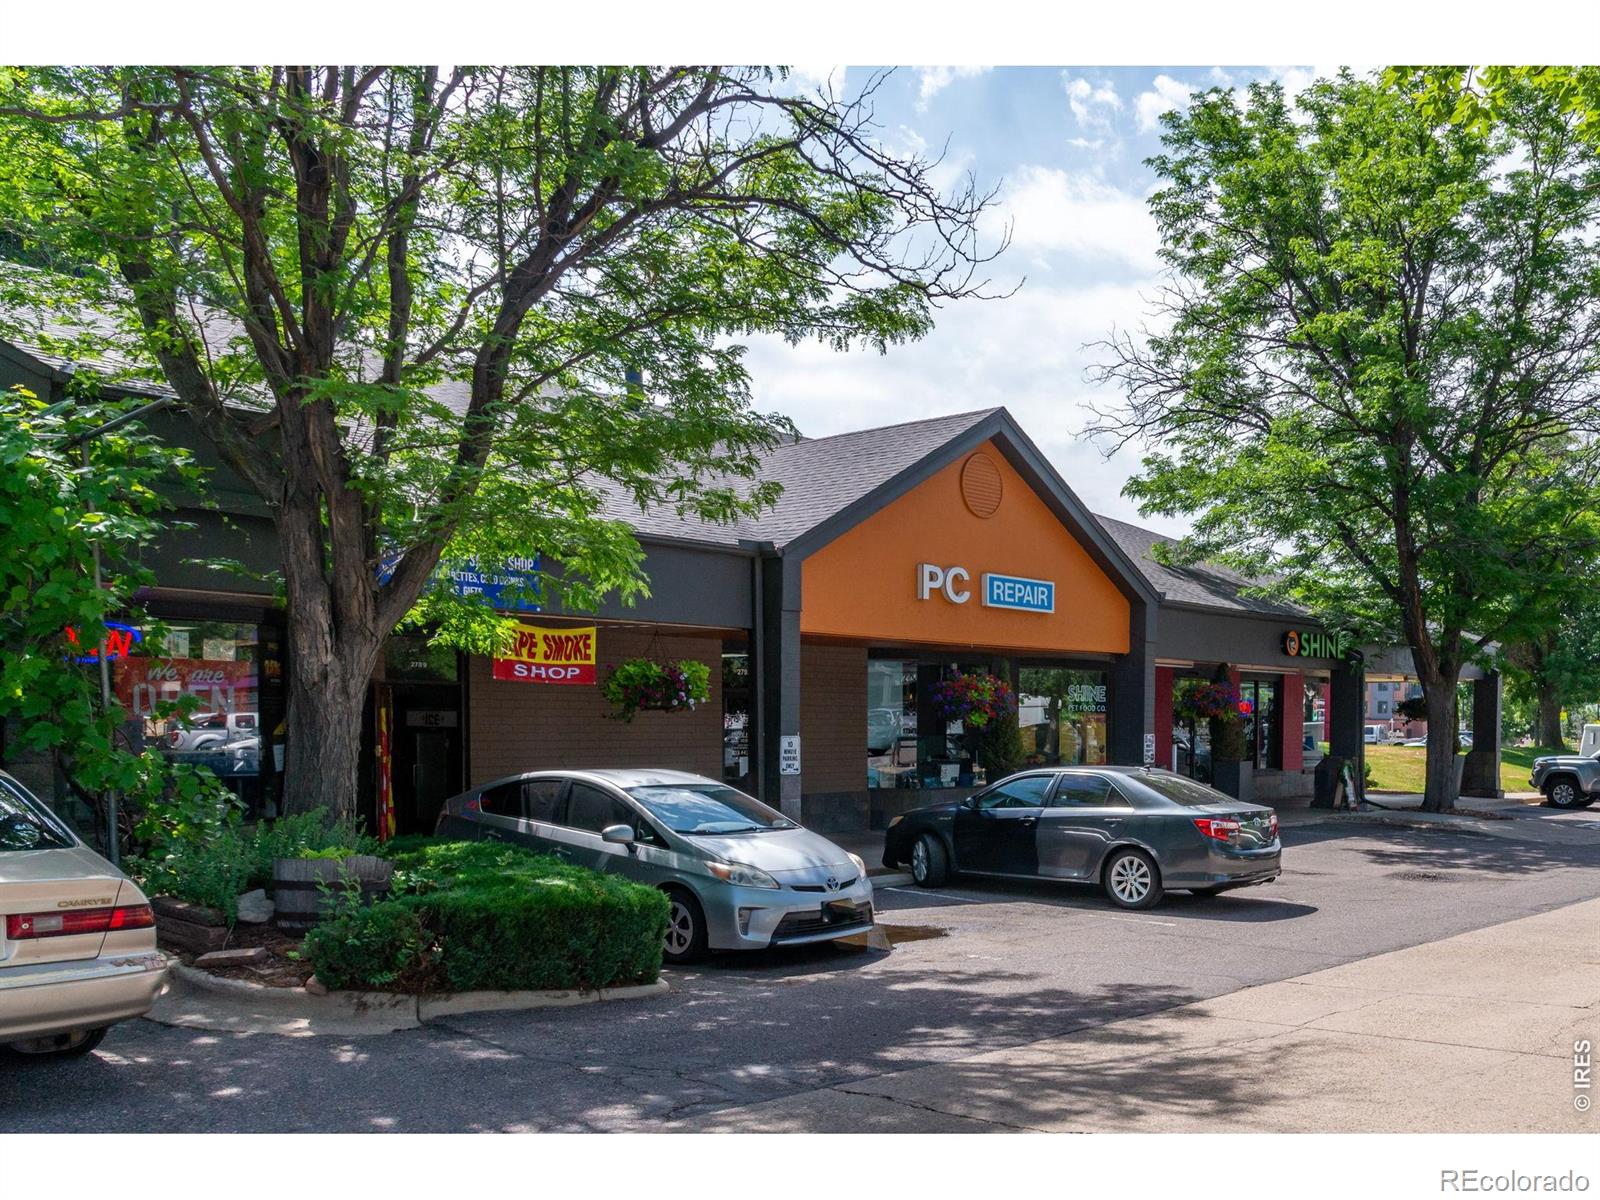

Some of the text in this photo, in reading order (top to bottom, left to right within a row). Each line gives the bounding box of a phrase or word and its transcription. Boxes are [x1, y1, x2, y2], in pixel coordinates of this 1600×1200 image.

[507, 556, 535, 572] SHOP
[918, 564, 1049, 607] PC REPAIR
[542, 633, 592, 662] SMOKE
[1300, 632, 1347, 660] SHINE
[148, 666, 179, 682] We
[513, 663, 581, 680] SHOP
[1067, 684, 1107, 703] SHINE
[1079, 704, 1096, 713] FOOD
